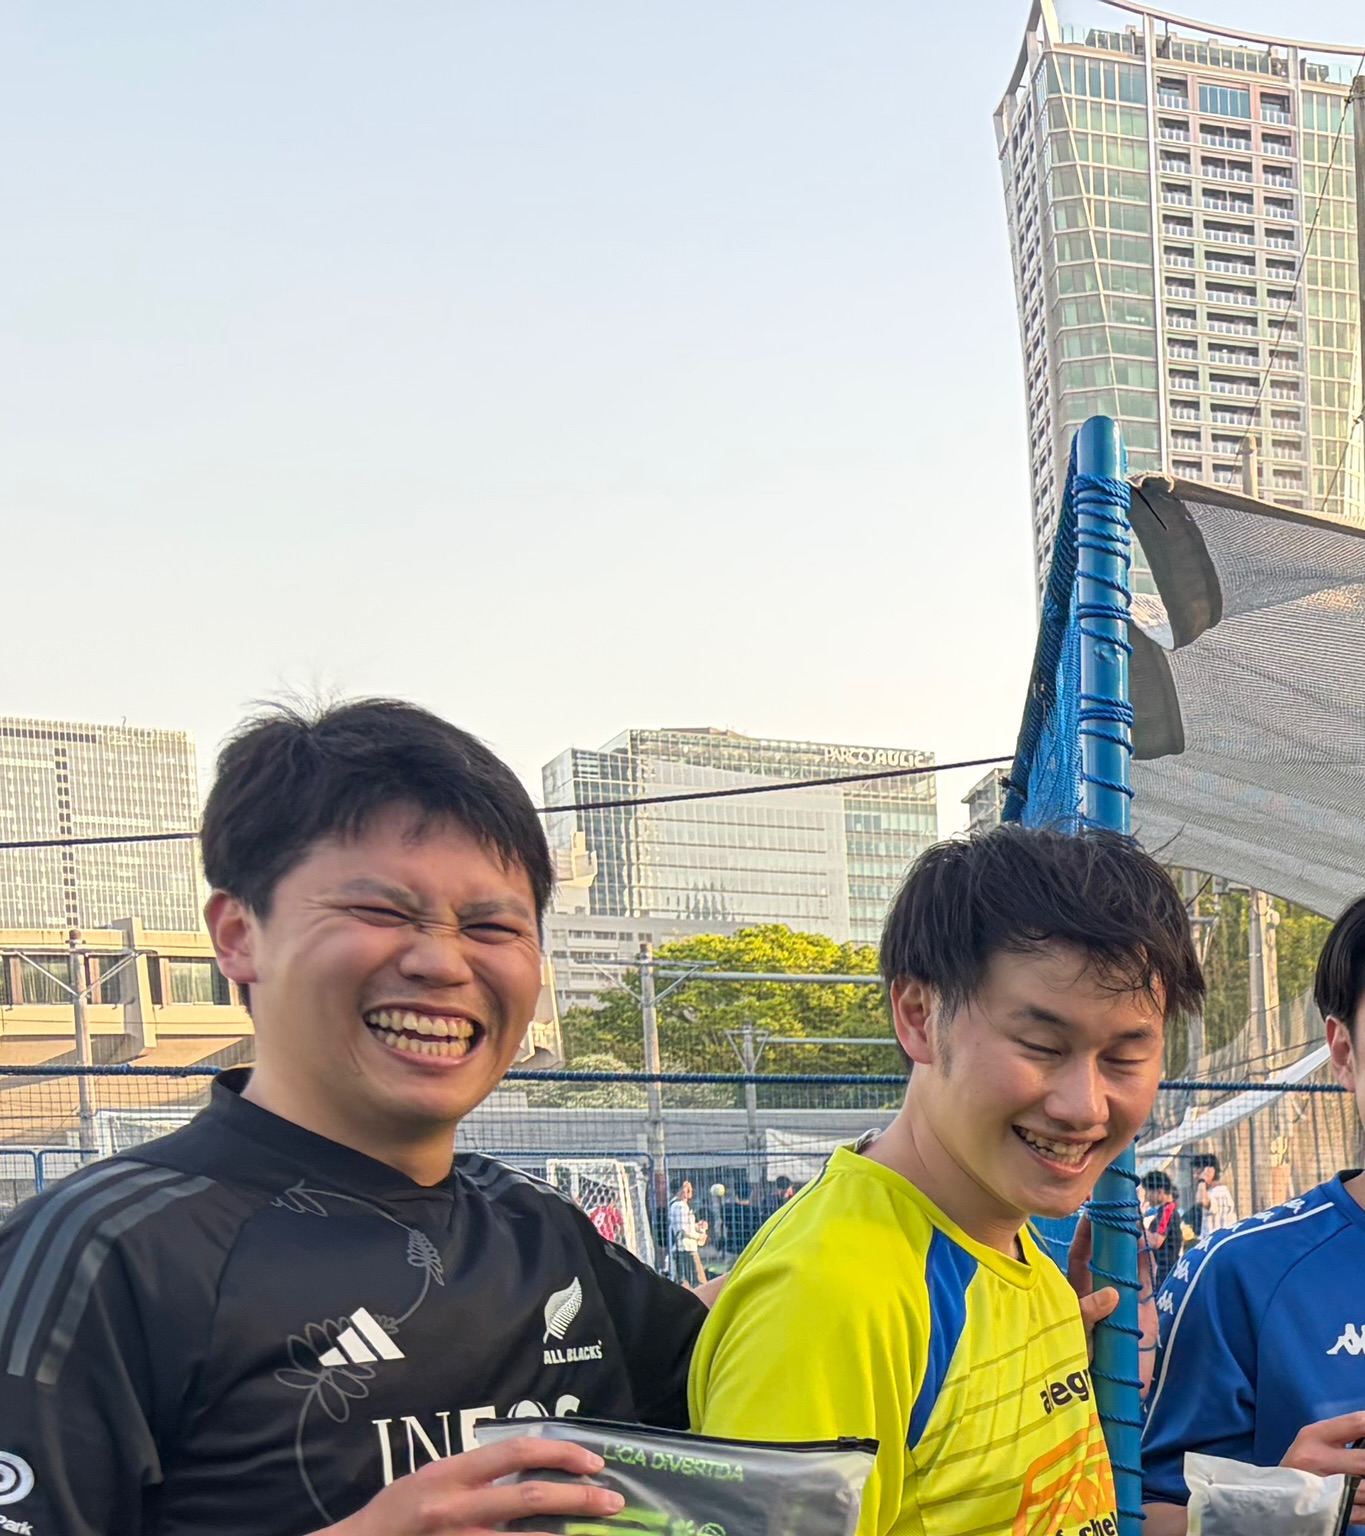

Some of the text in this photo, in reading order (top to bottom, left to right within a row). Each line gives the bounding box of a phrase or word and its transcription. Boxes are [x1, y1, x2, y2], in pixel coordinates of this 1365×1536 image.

[823, 746, 874, 765] PARCO
[543, 1345, 602, 1365] ALL BLACKS
